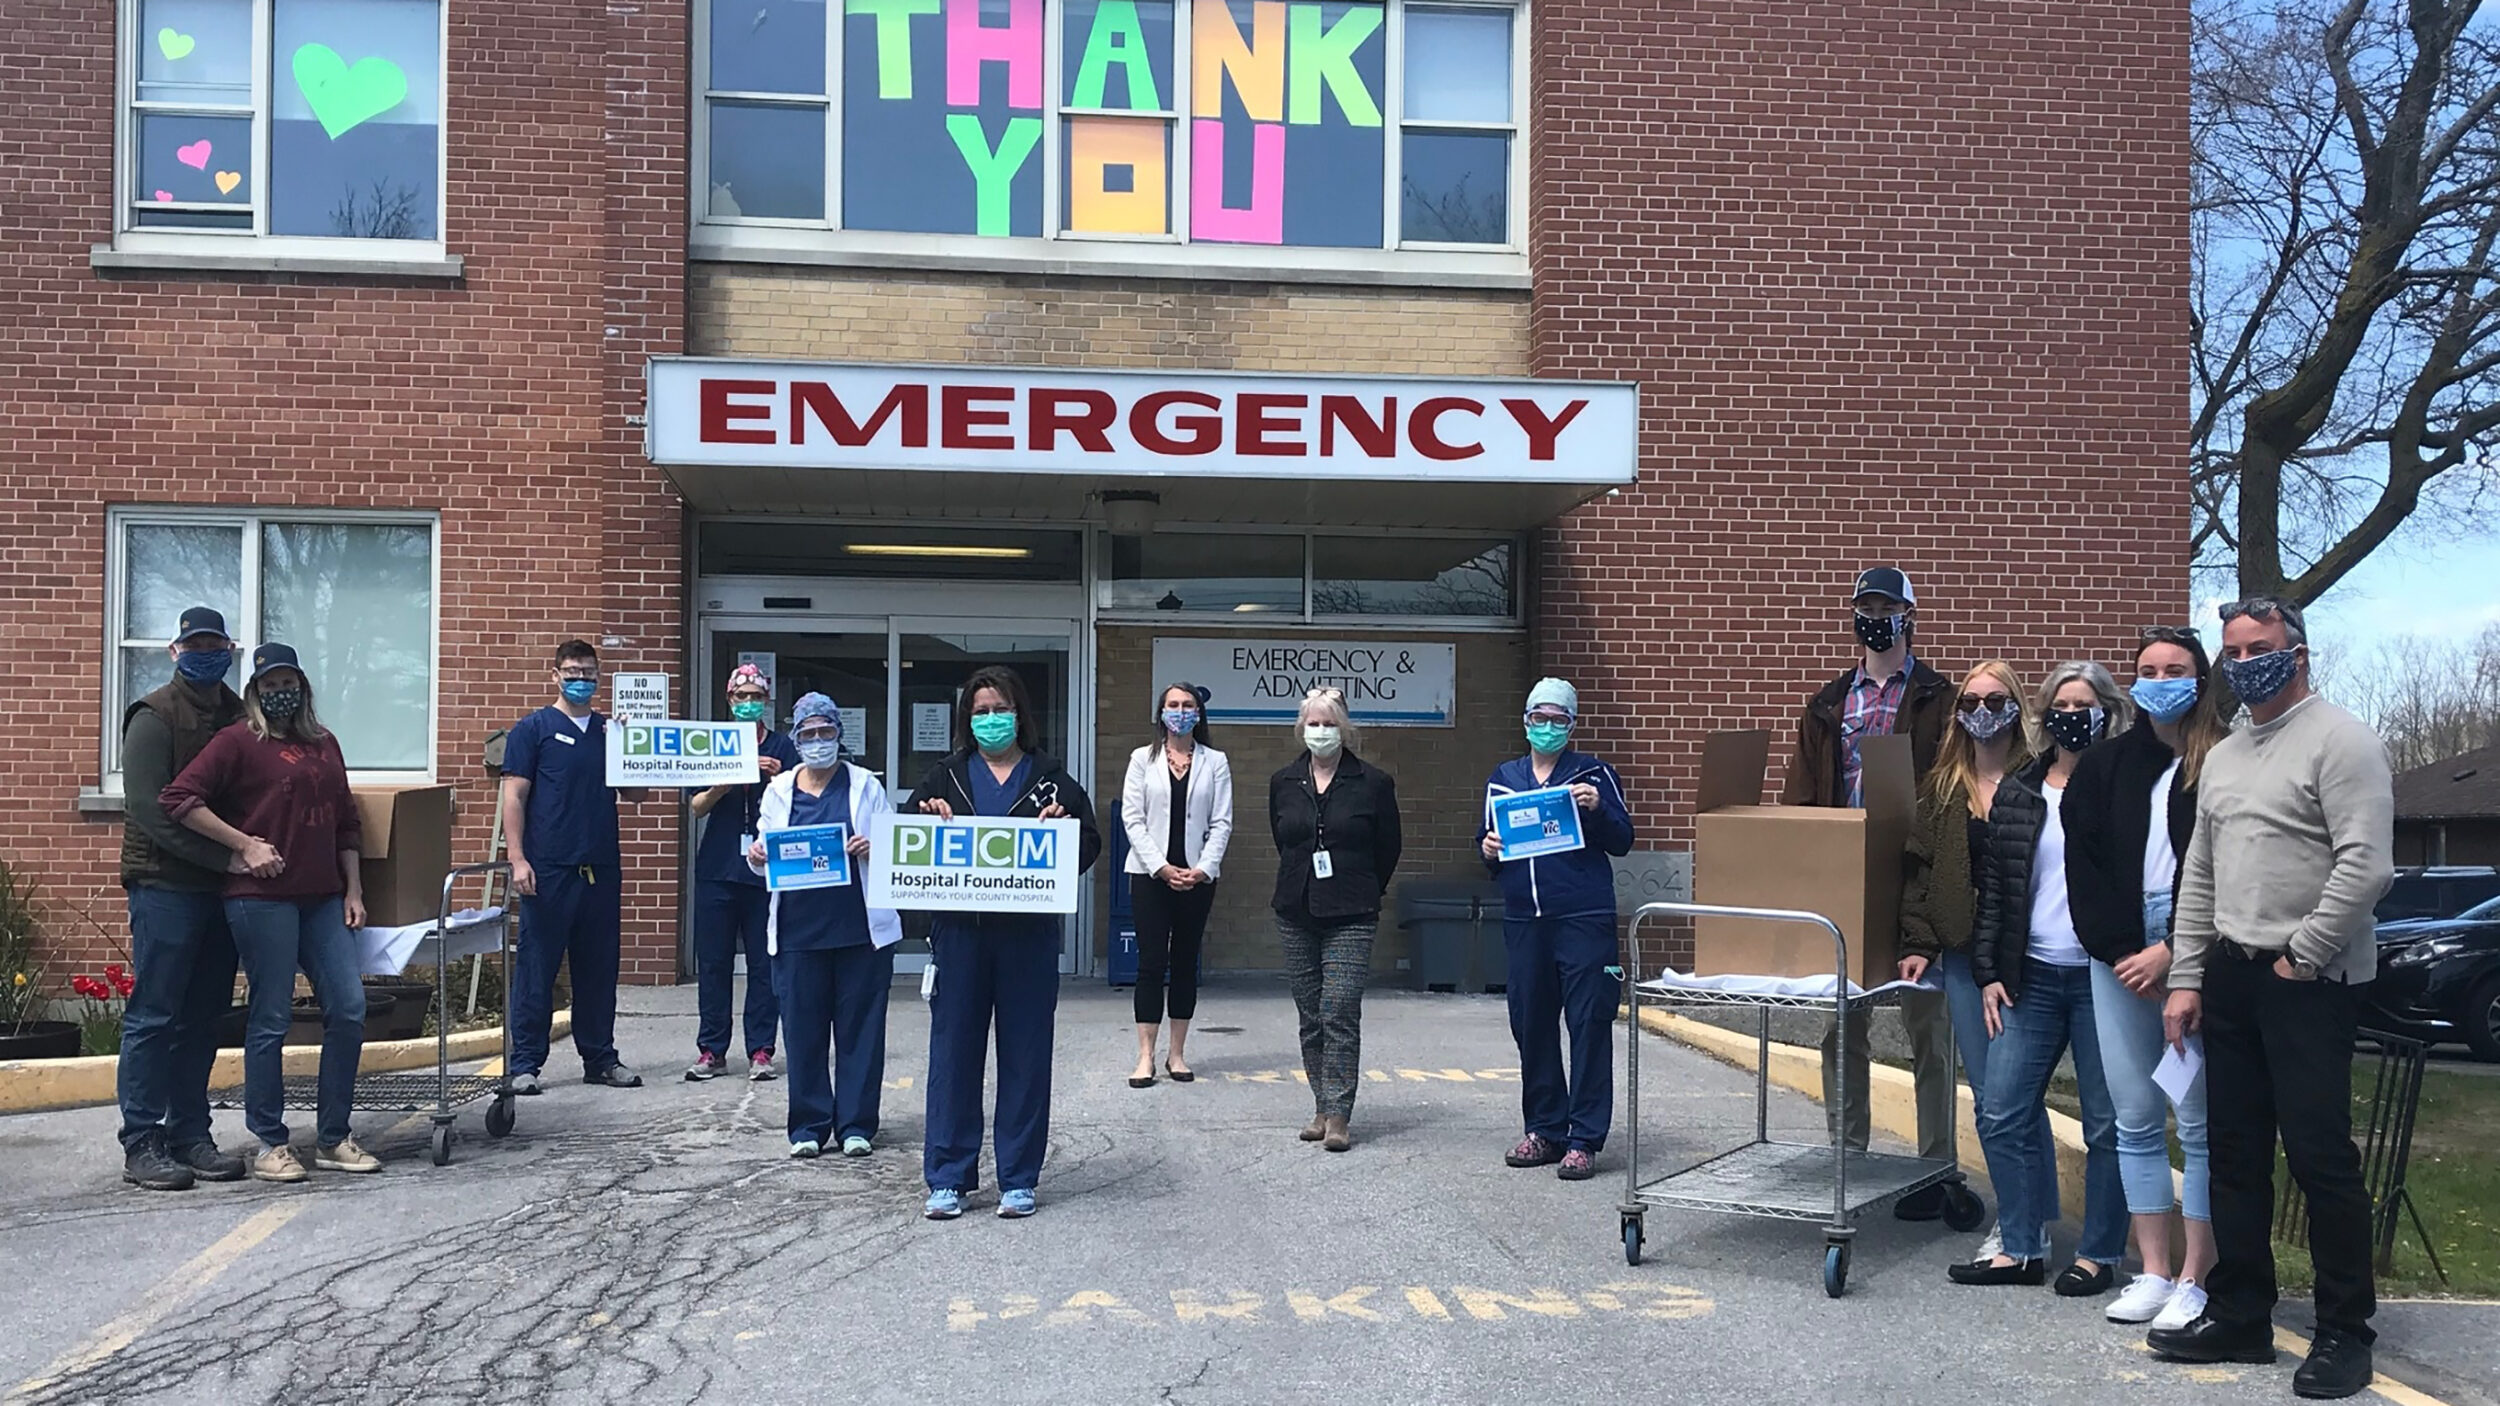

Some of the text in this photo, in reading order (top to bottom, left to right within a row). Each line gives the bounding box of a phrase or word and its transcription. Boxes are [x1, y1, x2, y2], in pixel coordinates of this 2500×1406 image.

[845, 0, 1383, 128] THANK
[945, 114, 1285, 245] YOU
[700, 379, 1590, 460] EMERGENCY
[1232, 648, 1416, 674] EMERGENCY &
[618, 689, 663, 700] SMOKING
[634, 677, 648, 688] NO
[627, 727, 741, 756] PECM
[623, 759, 743, 771] Hospital Foundation
[898, 827, 1055, 868] PECM
[891, 872, 1056, 889] Hospital Foundation
[891, 890, 1055, 903] SUPPORTING YOUR COUNTY HOSPITAL
